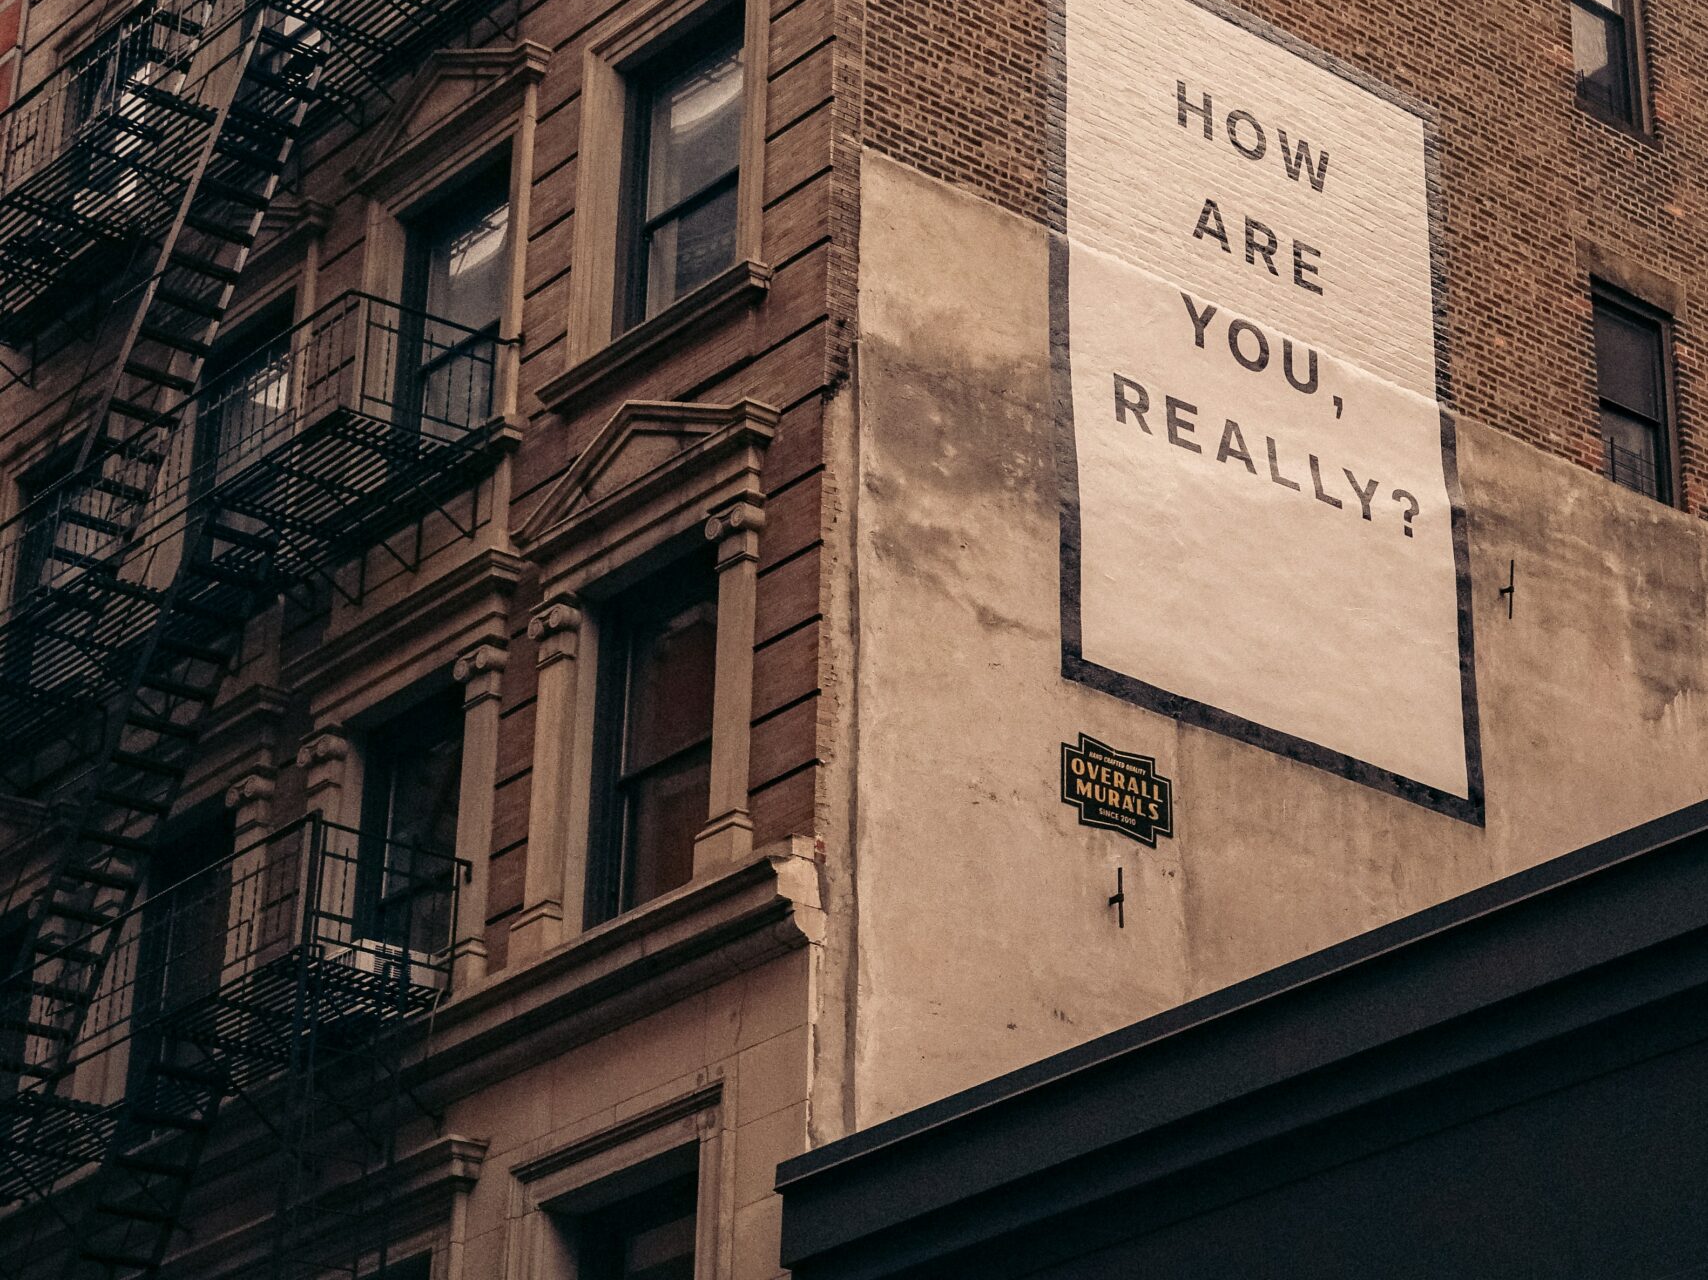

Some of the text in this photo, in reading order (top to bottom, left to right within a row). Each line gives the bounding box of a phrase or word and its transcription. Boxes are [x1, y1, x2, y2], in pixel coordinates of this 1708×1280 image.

[1176, 79, 1330, 193] HOW
[1192, 198, 1324, 296] ARE
[1179, 291, 1344, 420] YOU,
[1112, 372, 1421, 538] REALLY?
[1071, 757, 1164, 803] OVERALL
[1076, 778, 1159, 820] MURALS
[1104, 757, 1125, 768] CRAFTED
[1126, 764, 1146, 776] QUALITY
[1099, 808, 1136, 826] SINCE 2010
